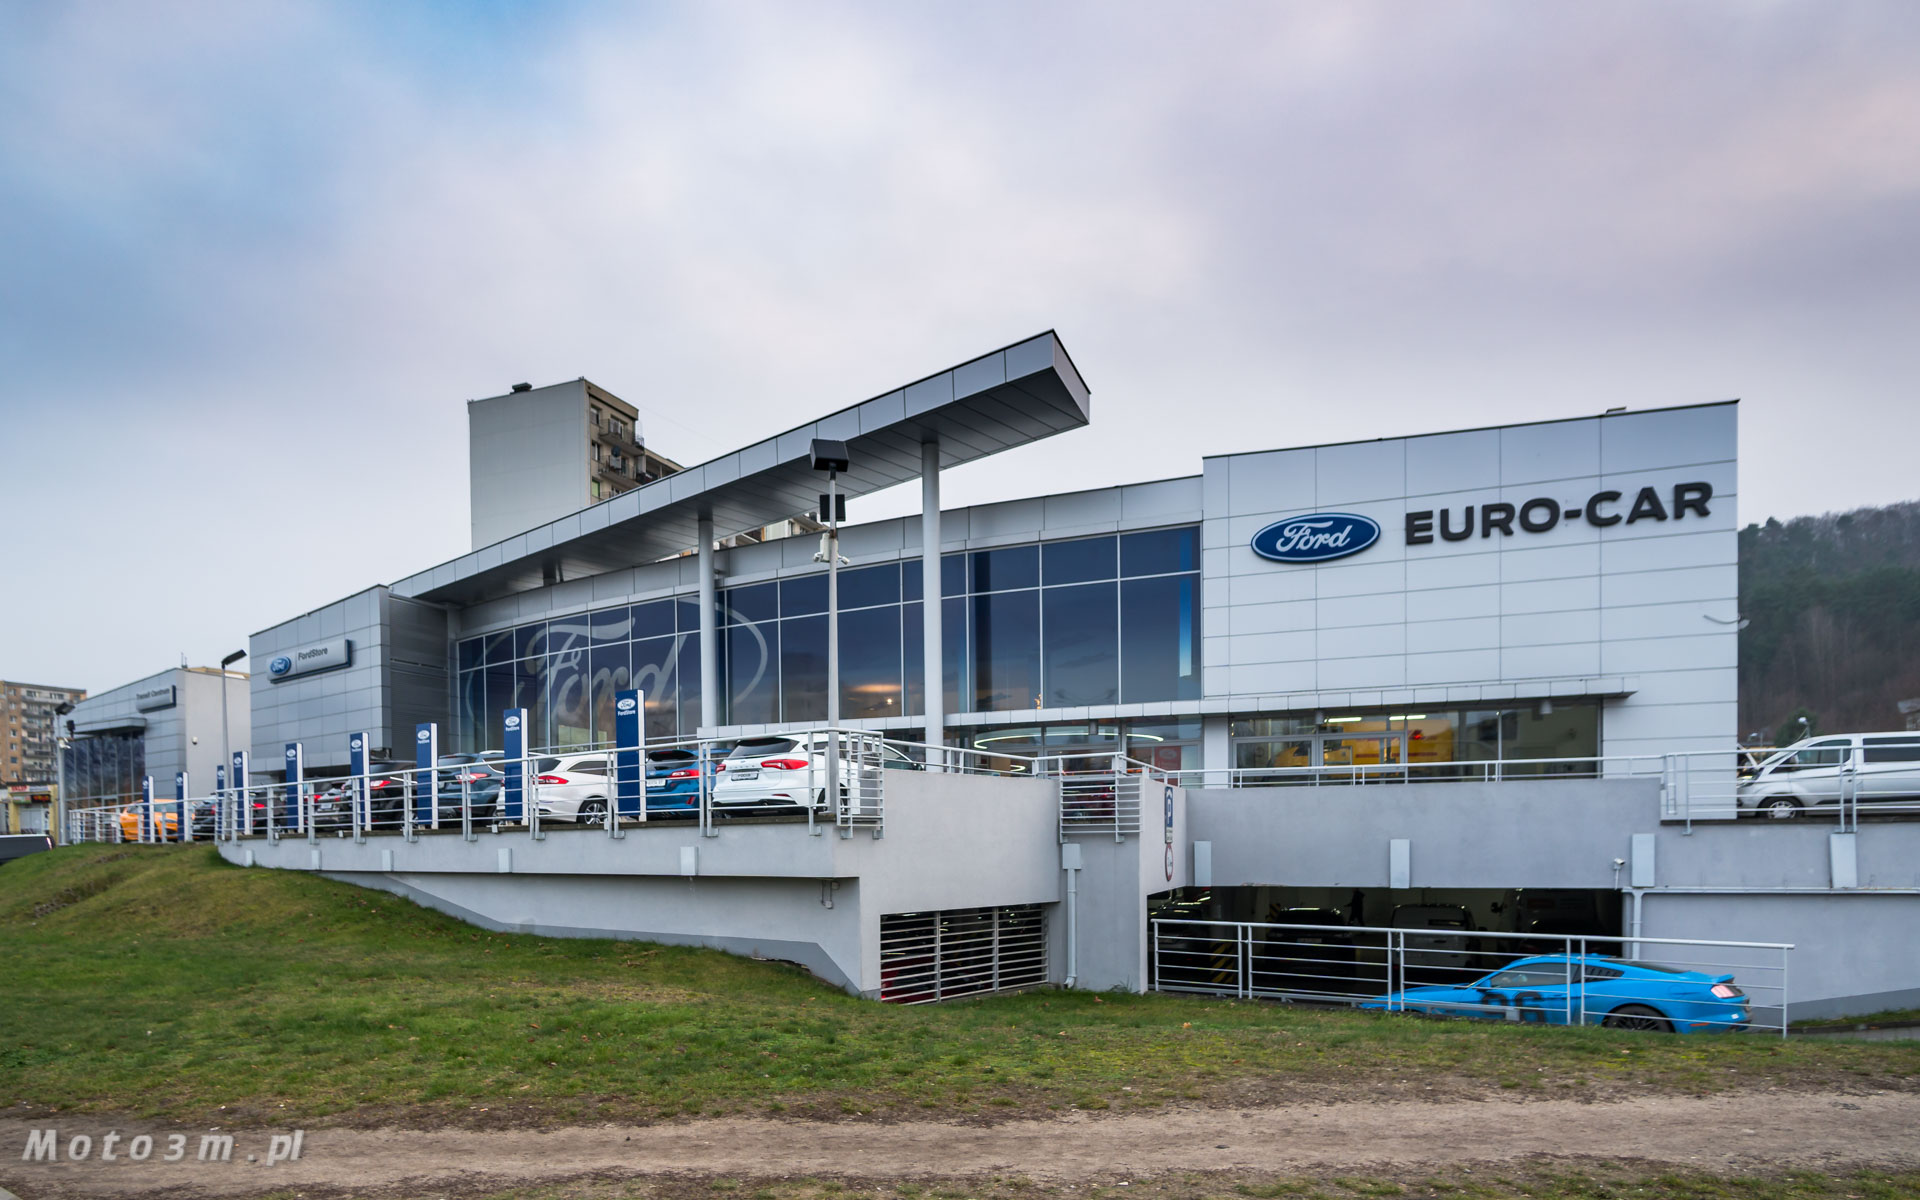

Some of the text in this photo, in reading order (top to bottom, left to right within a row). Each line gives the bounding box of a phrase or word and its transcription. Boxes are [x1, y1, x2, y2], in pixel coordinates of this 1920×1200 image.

[1405, 481, 1714, 546] EURO-CAR
[1275, 520, 1354, 553] Ford
[298, 647, 328, 661] FordStore
[510, 616, 689, 724] Ford
[617, 709, 636, 717] FordStore
